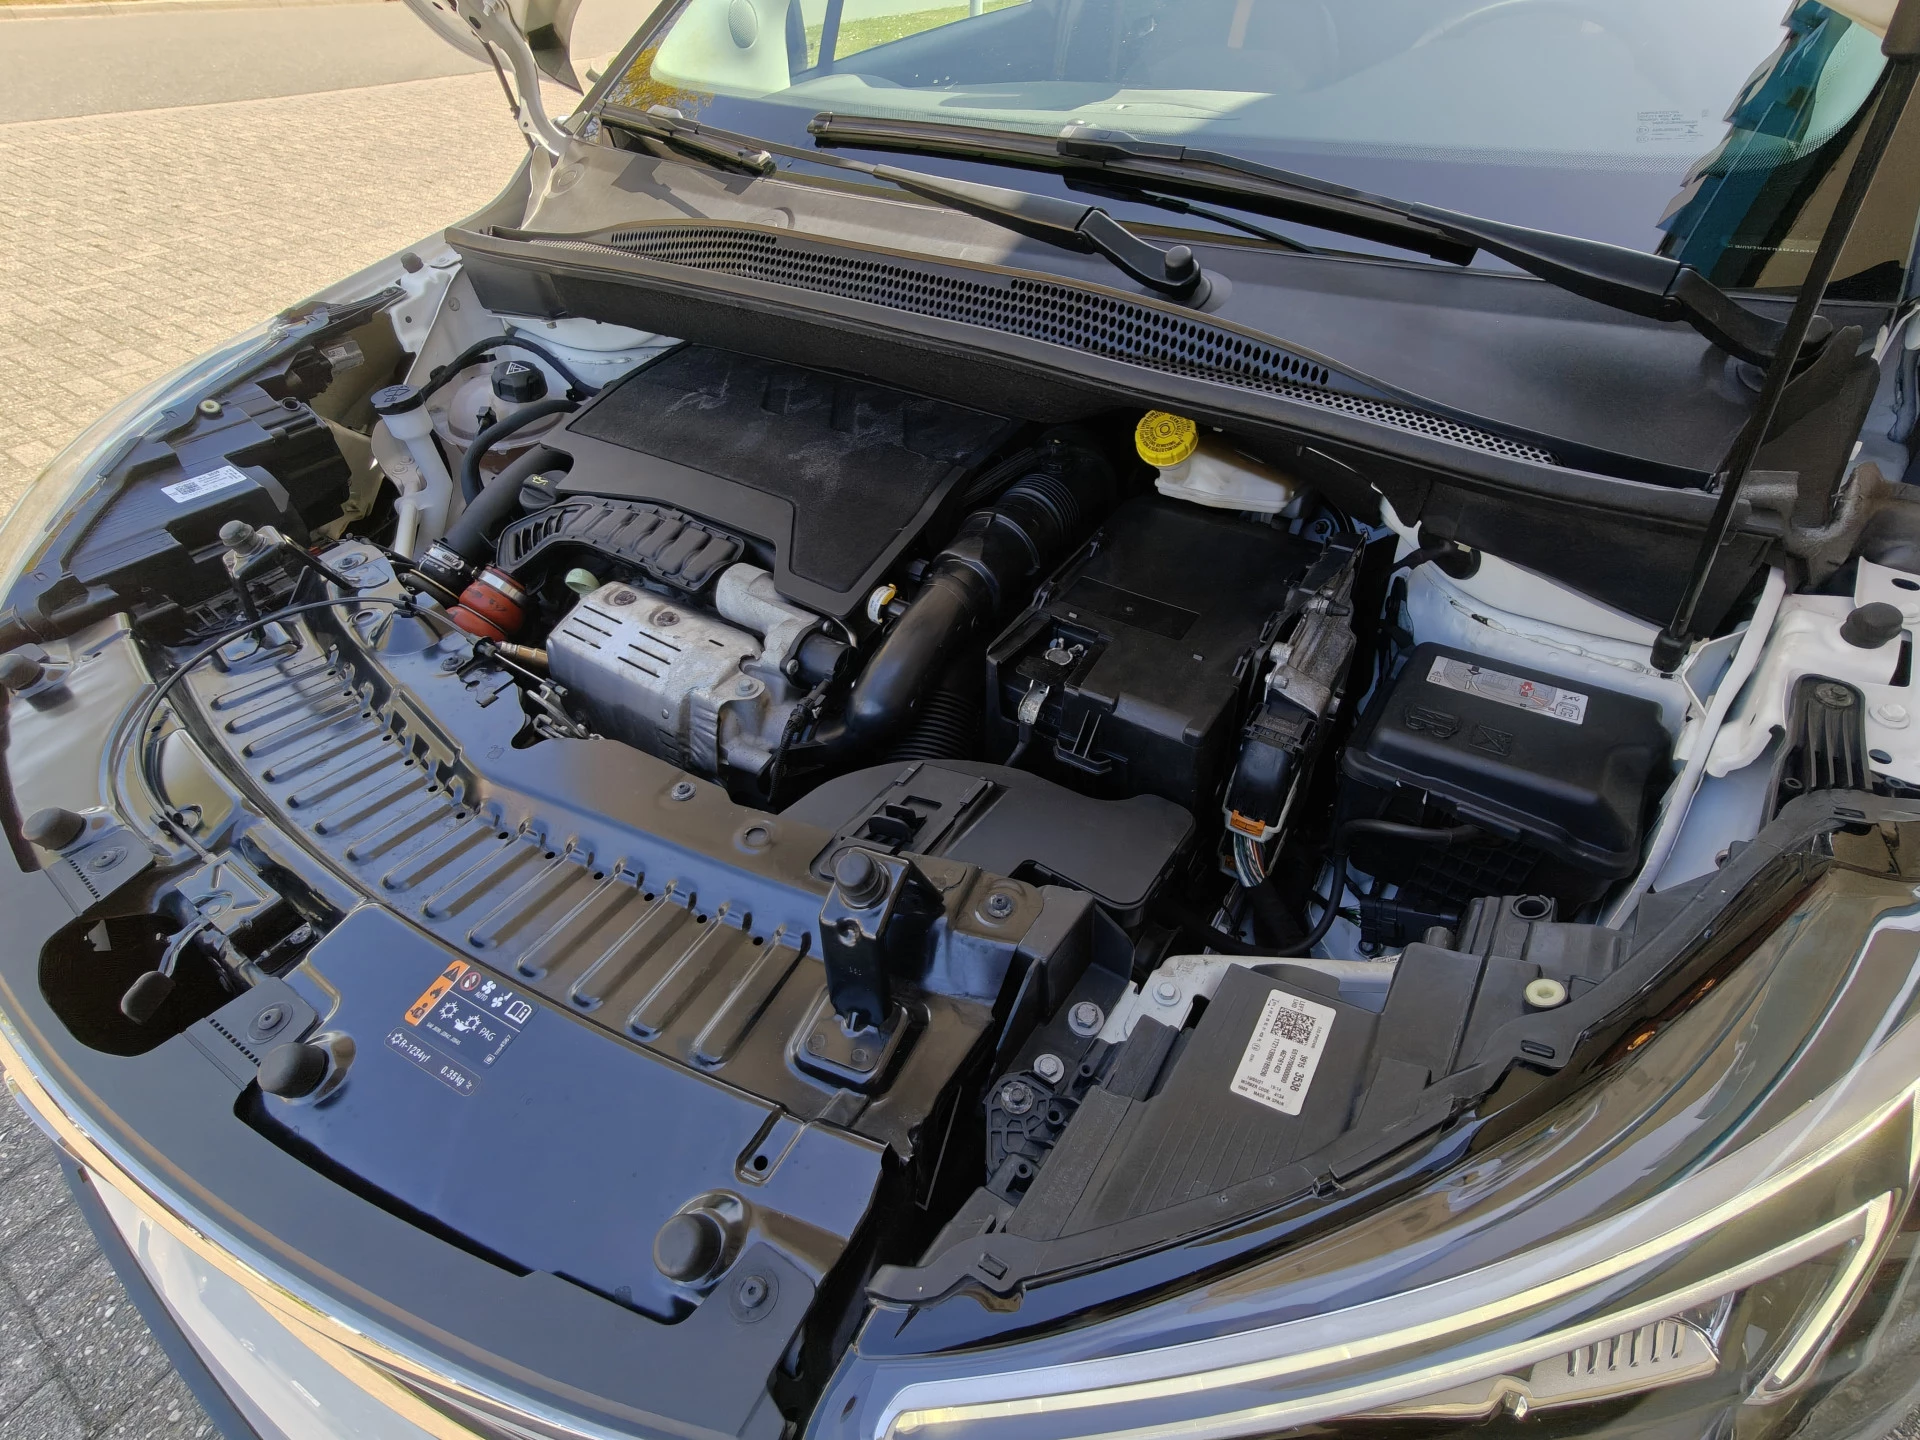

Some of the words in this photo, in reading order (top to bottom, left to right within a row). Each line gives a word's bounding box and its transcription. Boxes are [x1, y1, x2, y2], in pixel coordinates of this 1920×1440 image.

[474, 991, 488, 1002] AUTO
[478, 1027, 496, 1041] PAG
[399, 1039, 431, 1063] R-1234yf
[1297, 1054, 1308, 1068] 3915
[440, 1066, 465, 1087] 0.35kg
[1290, 1072, 1305, 1092] 3538
[1240, 1079, 1258, 1090] WORKER
[1253, 1091, 1265, 1100] MADE
[1271, 1098, 1285, 1107] SPAIN
